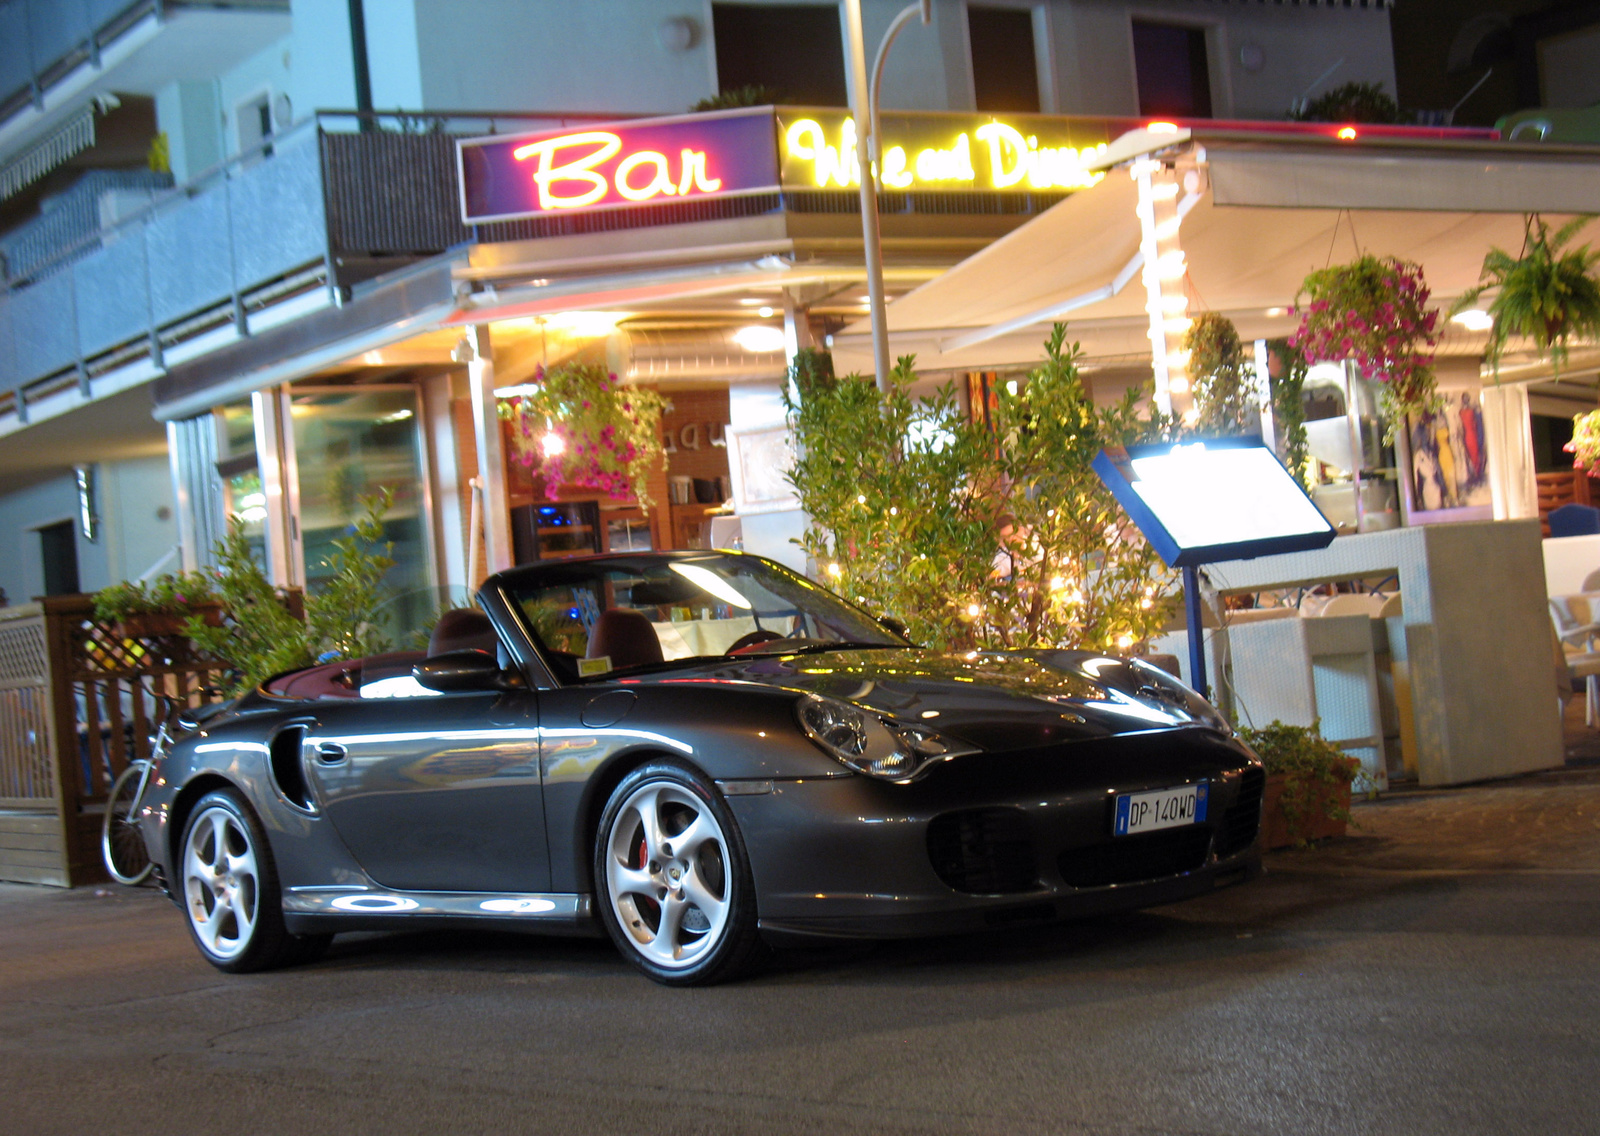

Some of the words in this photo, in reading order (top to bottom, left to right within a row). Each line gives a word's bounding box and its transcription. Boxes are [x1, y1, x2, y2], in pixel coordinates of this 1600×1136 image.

[513, 131, 722, 210] Bar
[786, 116, 914, 188] Wie
[916, 132, 976, 181] and
